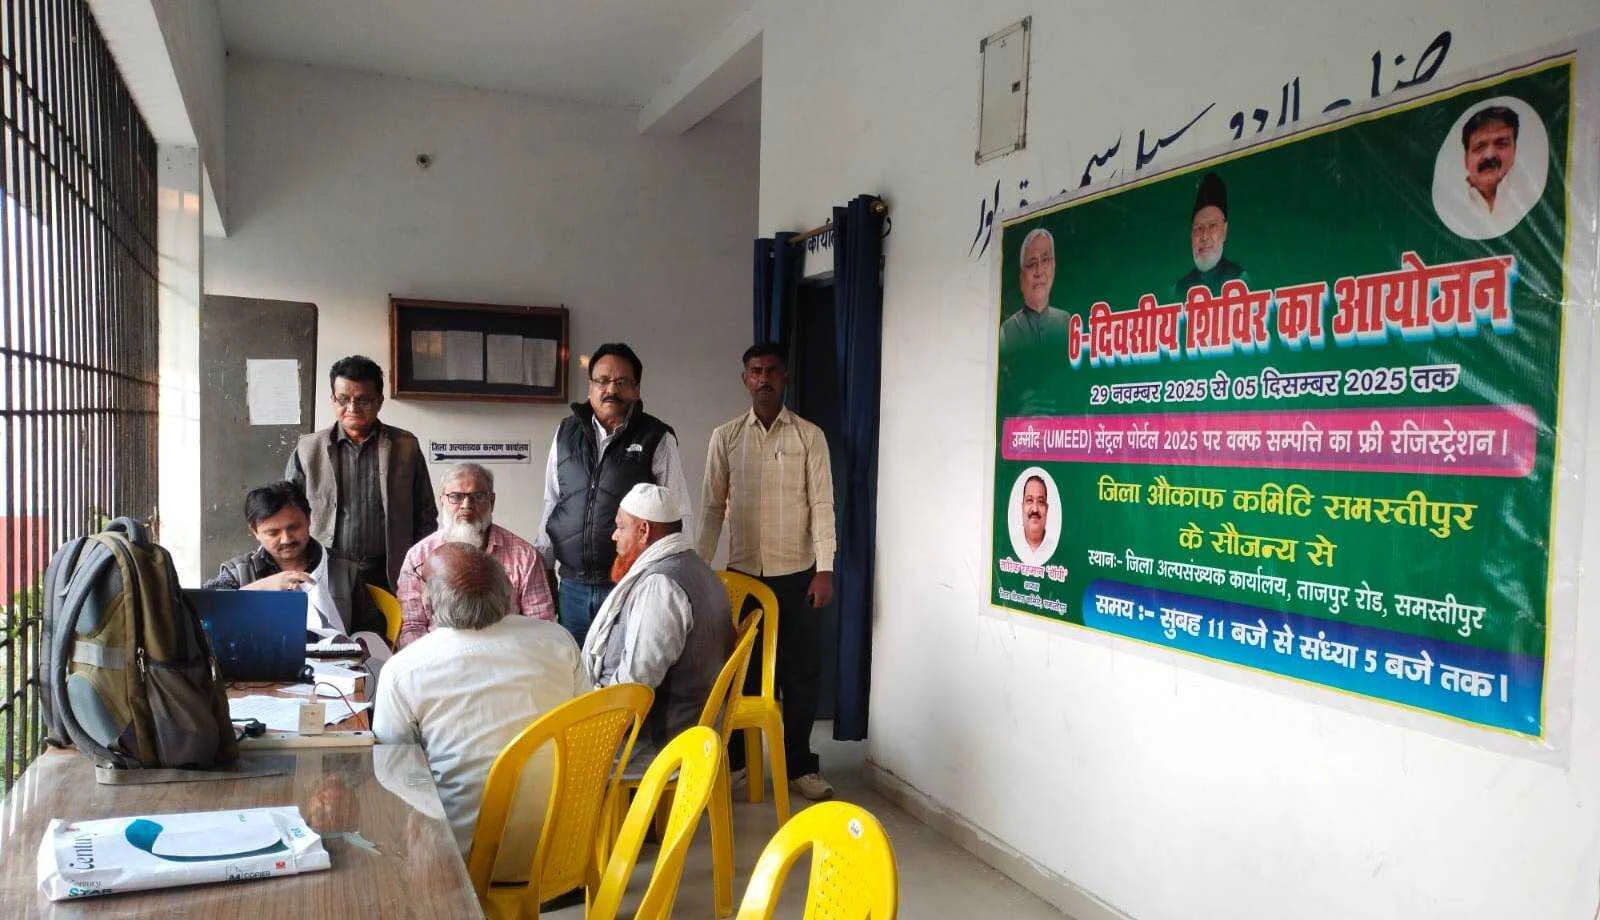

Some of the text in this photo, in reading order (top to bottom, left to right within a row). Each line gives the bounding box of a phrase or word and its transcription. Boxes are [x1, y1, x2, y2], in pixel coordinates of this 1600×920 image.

[1068, 251, 1515, 362] 6-दिवसीय शिविर का आयोजन
[1090, 363, 1461, 405] 29 नवम्बर 2025 से 05 दिसम्बर 2025 तक
[1043, 429, 1092, 453] (UMEED)
[1095, 424, 1124, 454] सेंट्रल
[1127, 422, 1159, 450] पोर्टल
[1163, 430, 1198, 451] 2025
[1202, 430, 1223, 451] पर
[1226, 430, 1262, 452] वक्फ
[1266, 420, 1323, 453] सम्पत्ति
[1328, 429, 1353, 453] का
[1357, 420, 1385, 454] फ्री
[1097, 475, 1479, 539] जिला औकाफ कमिटि समस्तीपुर
[1179, 522, 1338, 568] के सौजन्य से
[1125, 548, 1154, 576] जिला
[1157, 558, 1226, 587] अल्पसंख्यक
[1229, 566, 1291, 602] कार्यालय,
[1297, 580, 1350, 615] ताजपुर
[1355, 580, 1388, 618] रोड,
[1394, 593, 1487, 638] समस्तीपुर
[1095, 594, 1135, 620] समय
[1159, 607, 1203, 640] सुबह
[1208, 617, 1224, 640] 11
[1230, 618, 1269, 649] बजे
[1273, 622, 1295, 655] से
[1299, 630, 1359, 669] संध्या
[1364, 650, 1378, 673] 5
[1384, 650, 1434, 685] बजे
